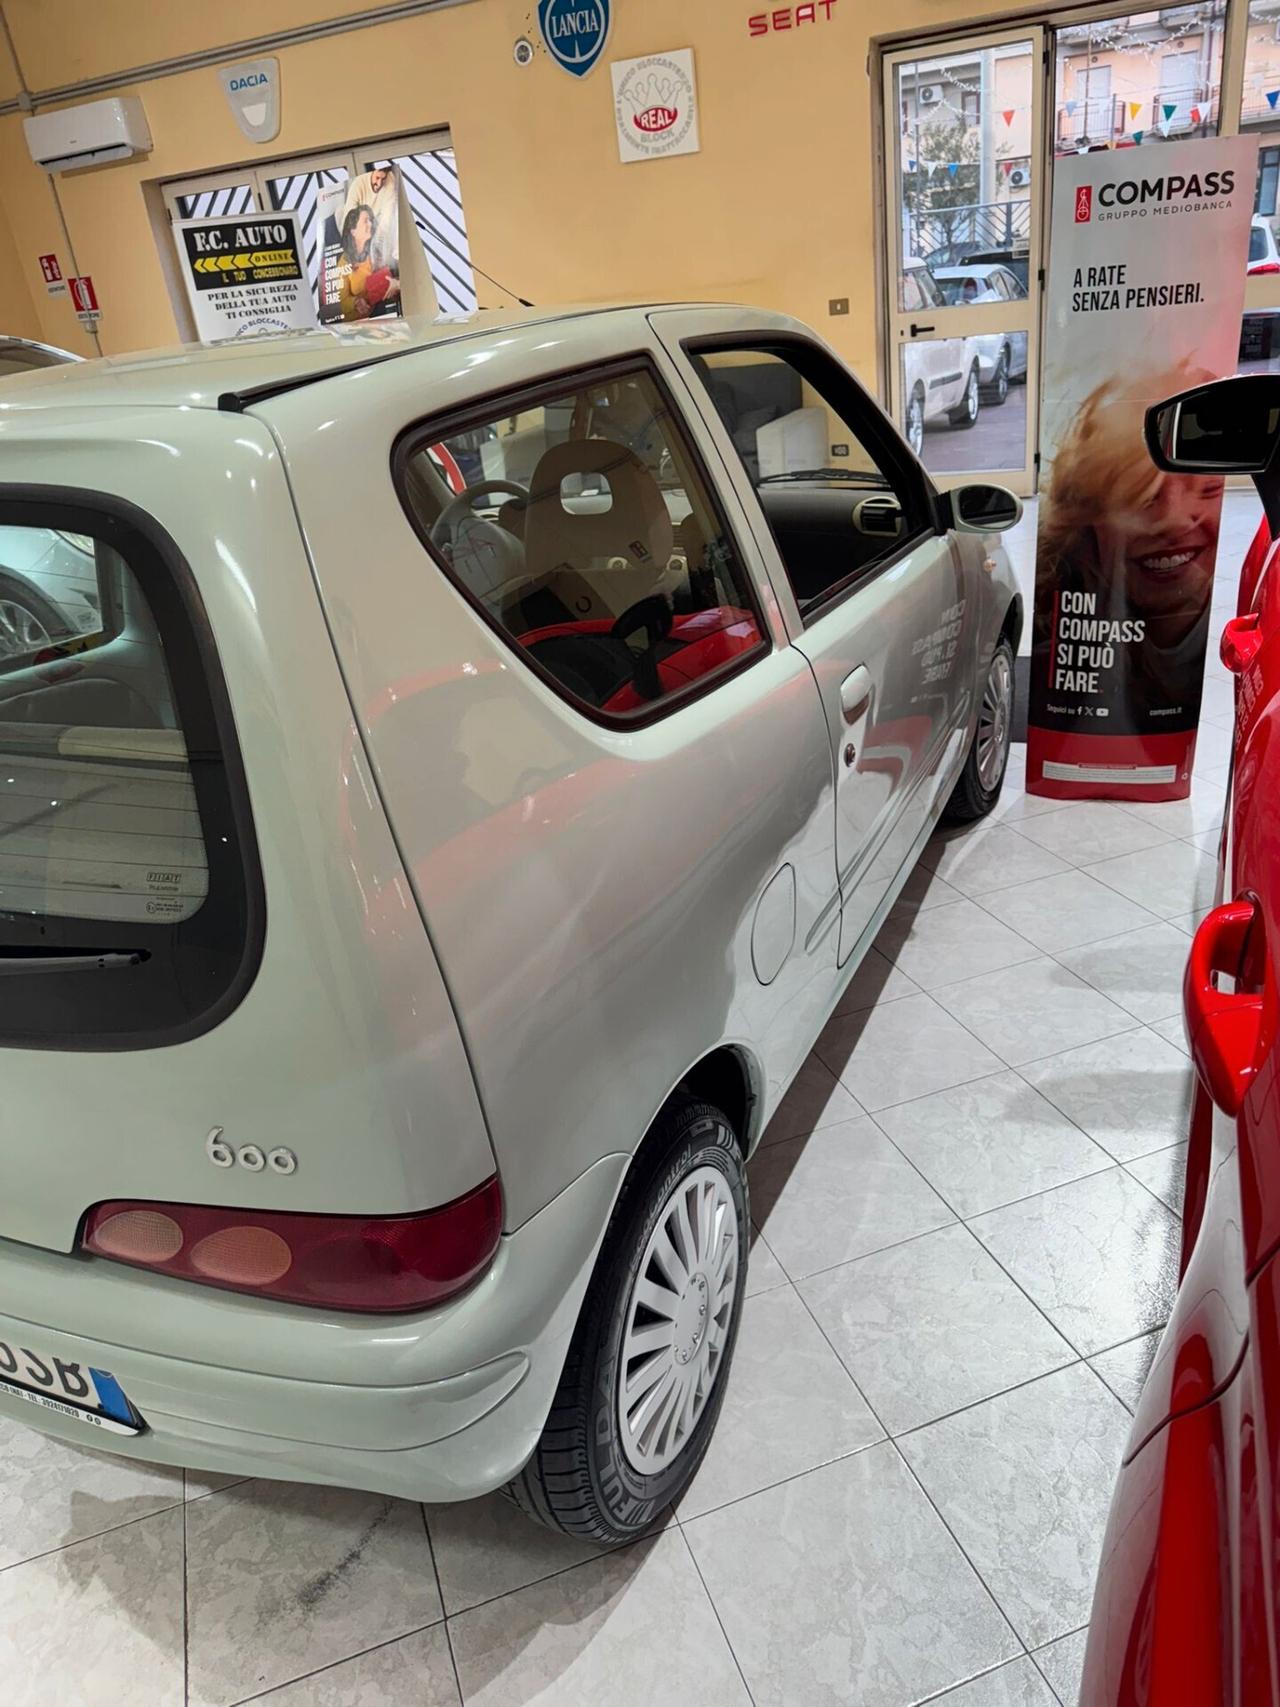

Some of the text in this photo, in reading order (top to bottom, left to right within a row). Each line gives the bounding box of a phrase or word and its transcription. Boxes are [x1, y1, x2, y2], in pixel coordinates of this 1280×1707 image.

[551, 9, 600, 38] LANCIA
[748, 0, 837, 36] SEAT
[230, 73, 268, 91] DACIA
[640, 109, 673, 129] REAL
[640, 130, 675, 143] BLOCK
[1098, 170, 1235, 207] COMPASS
[1098, 200, 1233, 222] GRUPPO MEDIOBANCA
[235, 224, 287, 247] AUTO
[254, 252, 289, 263] ONLINE
[1074, 264, 1127, 288] A RATE
[208, 284, 298, 301] PER LA SICUREZZA
[215, 294, 297, 311] DELLA TUA AUTO
[1072, 282, 1205, 313] SENZA PENSIERI.
[226, 304, 292, 320] TI CONSIGLIA
[1061, 590, 1096, 616] CON
[1058, 617, 1146, 643] COMPASS
[1057, 642, 1115, 669] SI PUÒ
[1047, 704, 1067, 714] Seguici
[1149, 706, 1182, 716] compass.it
[206, 1126, 298, 1176] 600
